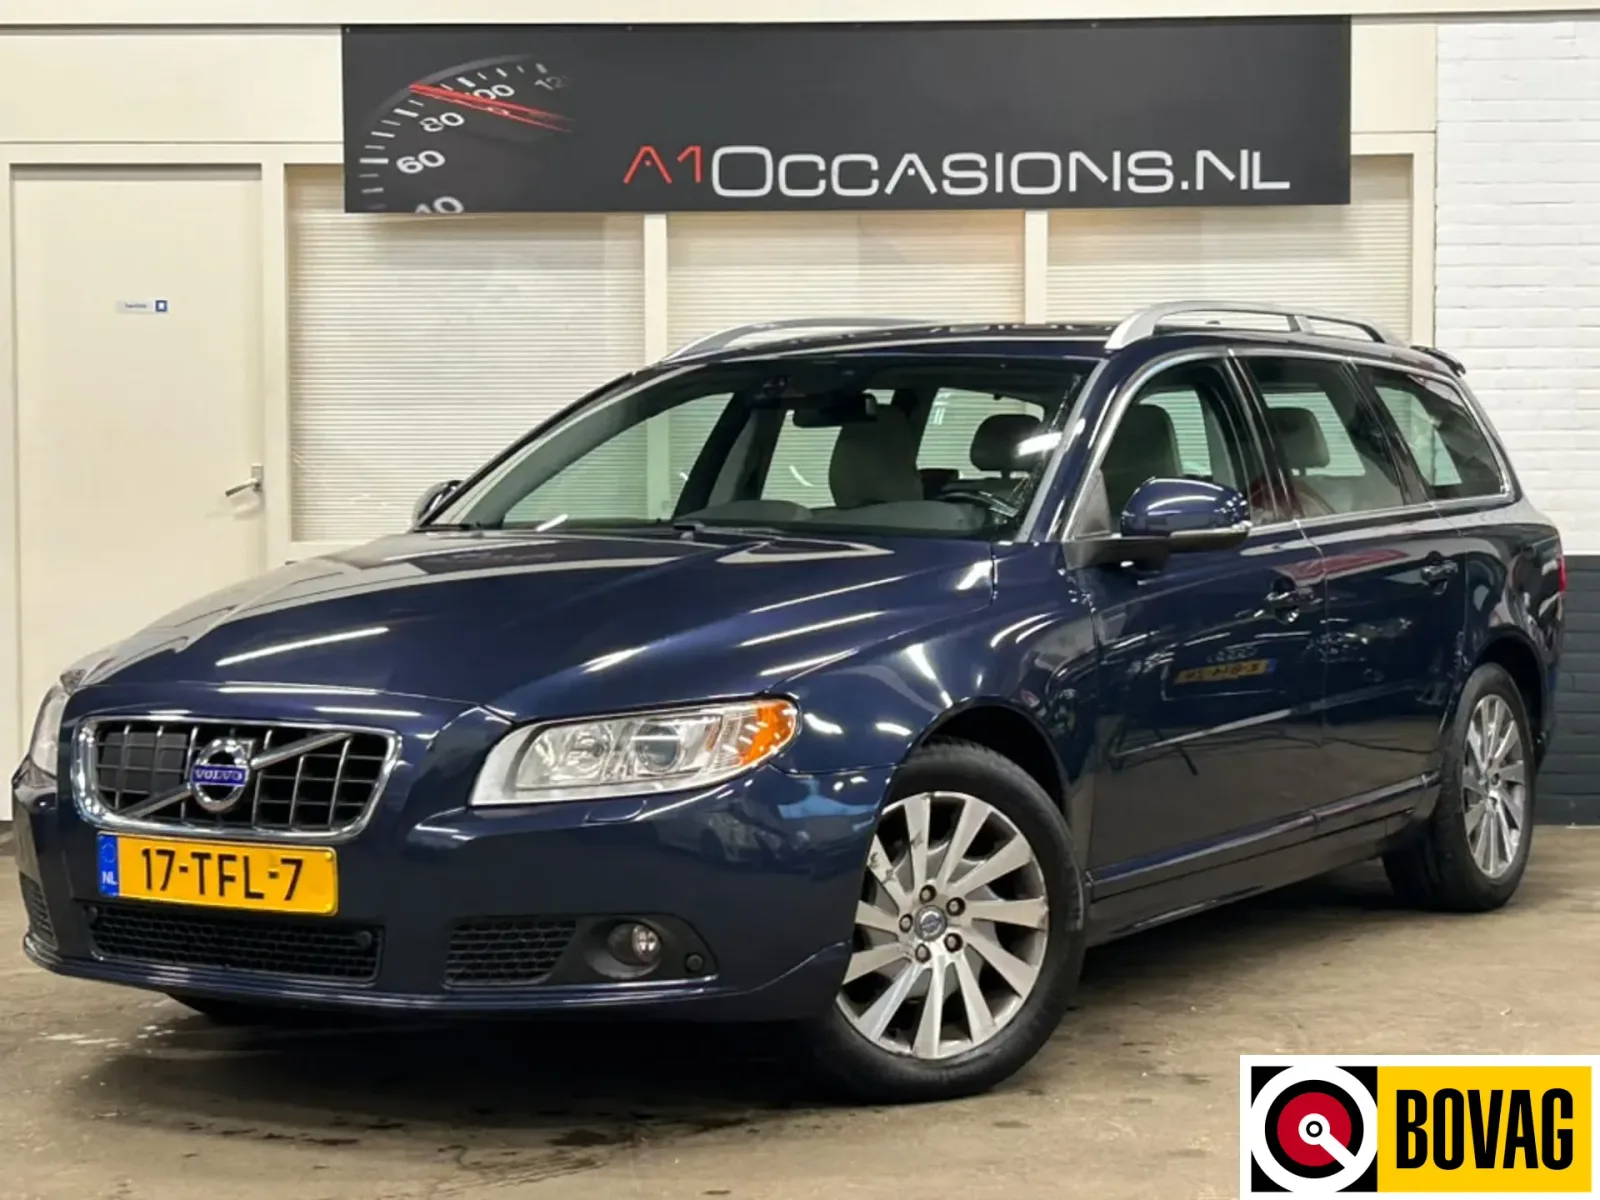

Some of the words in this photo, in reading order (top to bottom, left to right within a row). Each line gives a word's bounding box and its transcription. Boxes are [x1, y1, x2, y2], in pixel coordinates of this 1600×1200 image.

[419, 112, 465, 132] 80
[396, 150, 445, 174] 60
[195, 768, 243, 781] VOLVO
[101, 870, 118, 886] NL
[141, 848, 304, 901] 17-TFL-7
